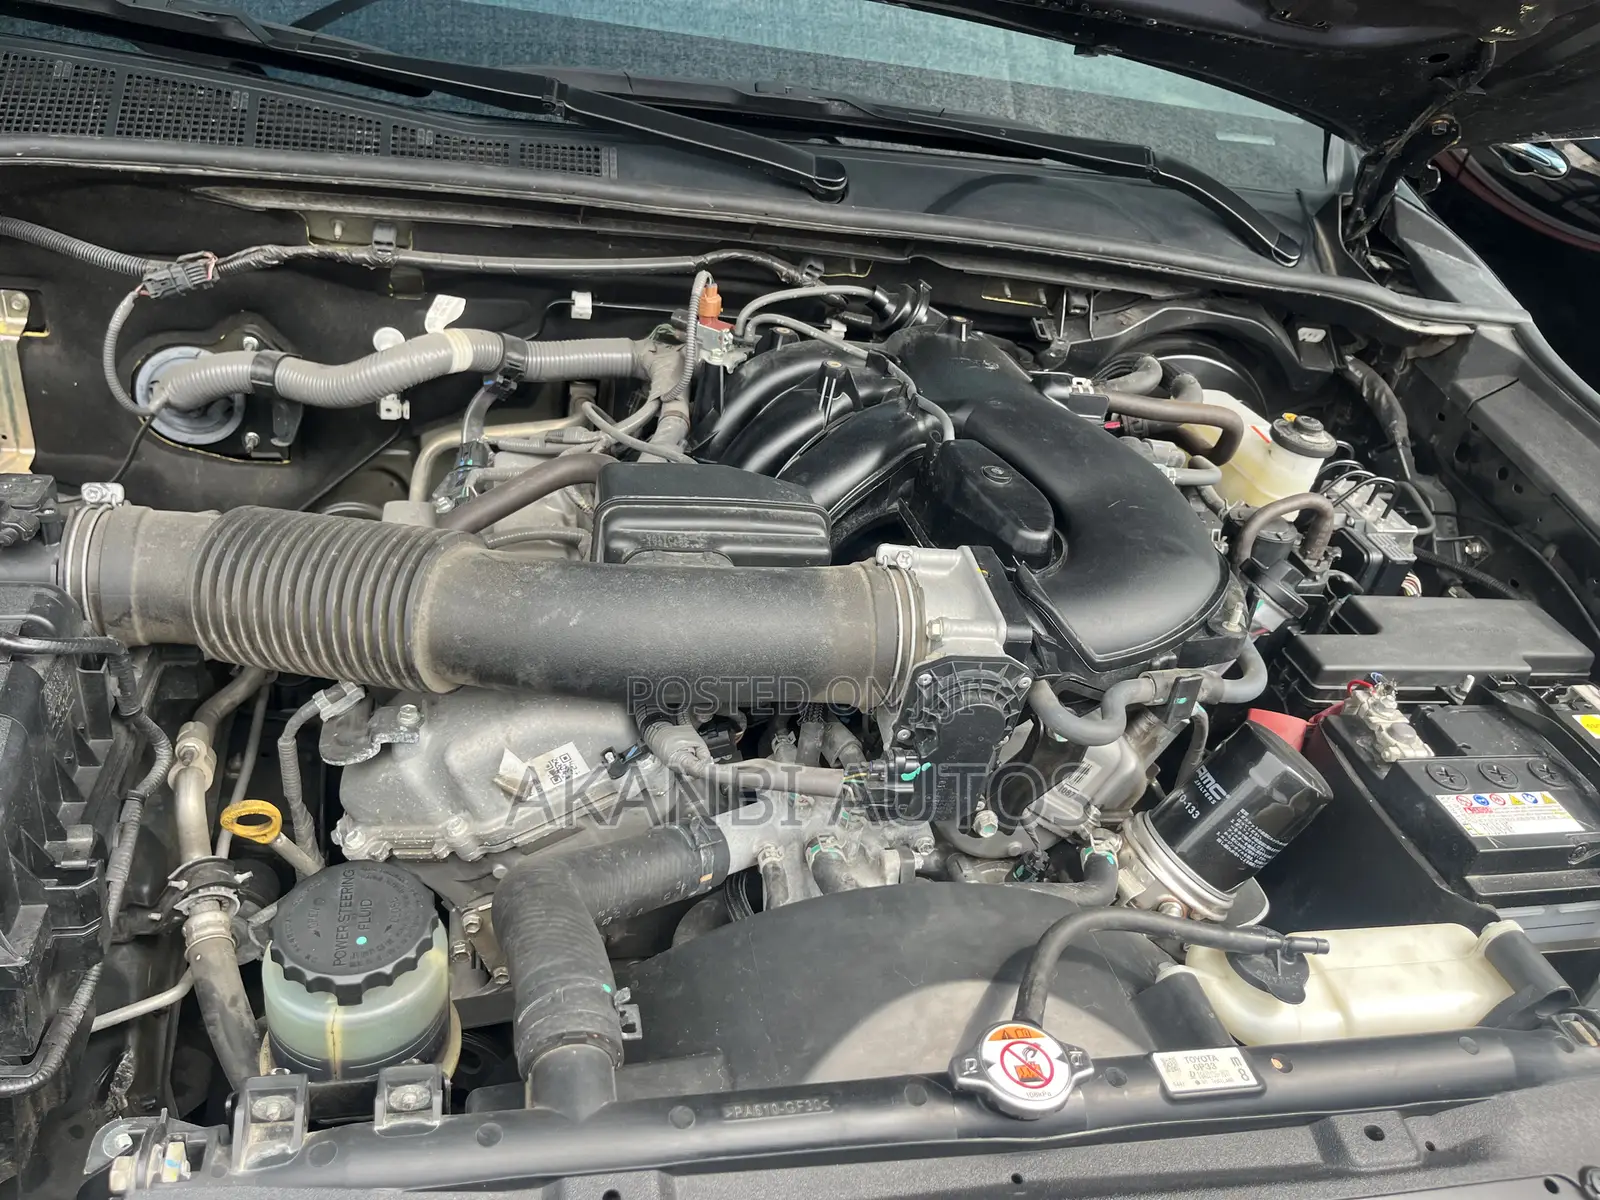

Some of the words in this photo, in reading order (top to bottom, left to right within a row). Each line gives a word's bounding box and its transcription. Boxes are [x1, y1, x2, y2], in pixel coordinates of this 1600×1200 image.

[338, 869, 356, 924] STEERING
[358, 899, 373, 931] FLUID
[333, 924, 350, 967] POWER
[1184, 1055, 1220, 1064] TOYOTA
